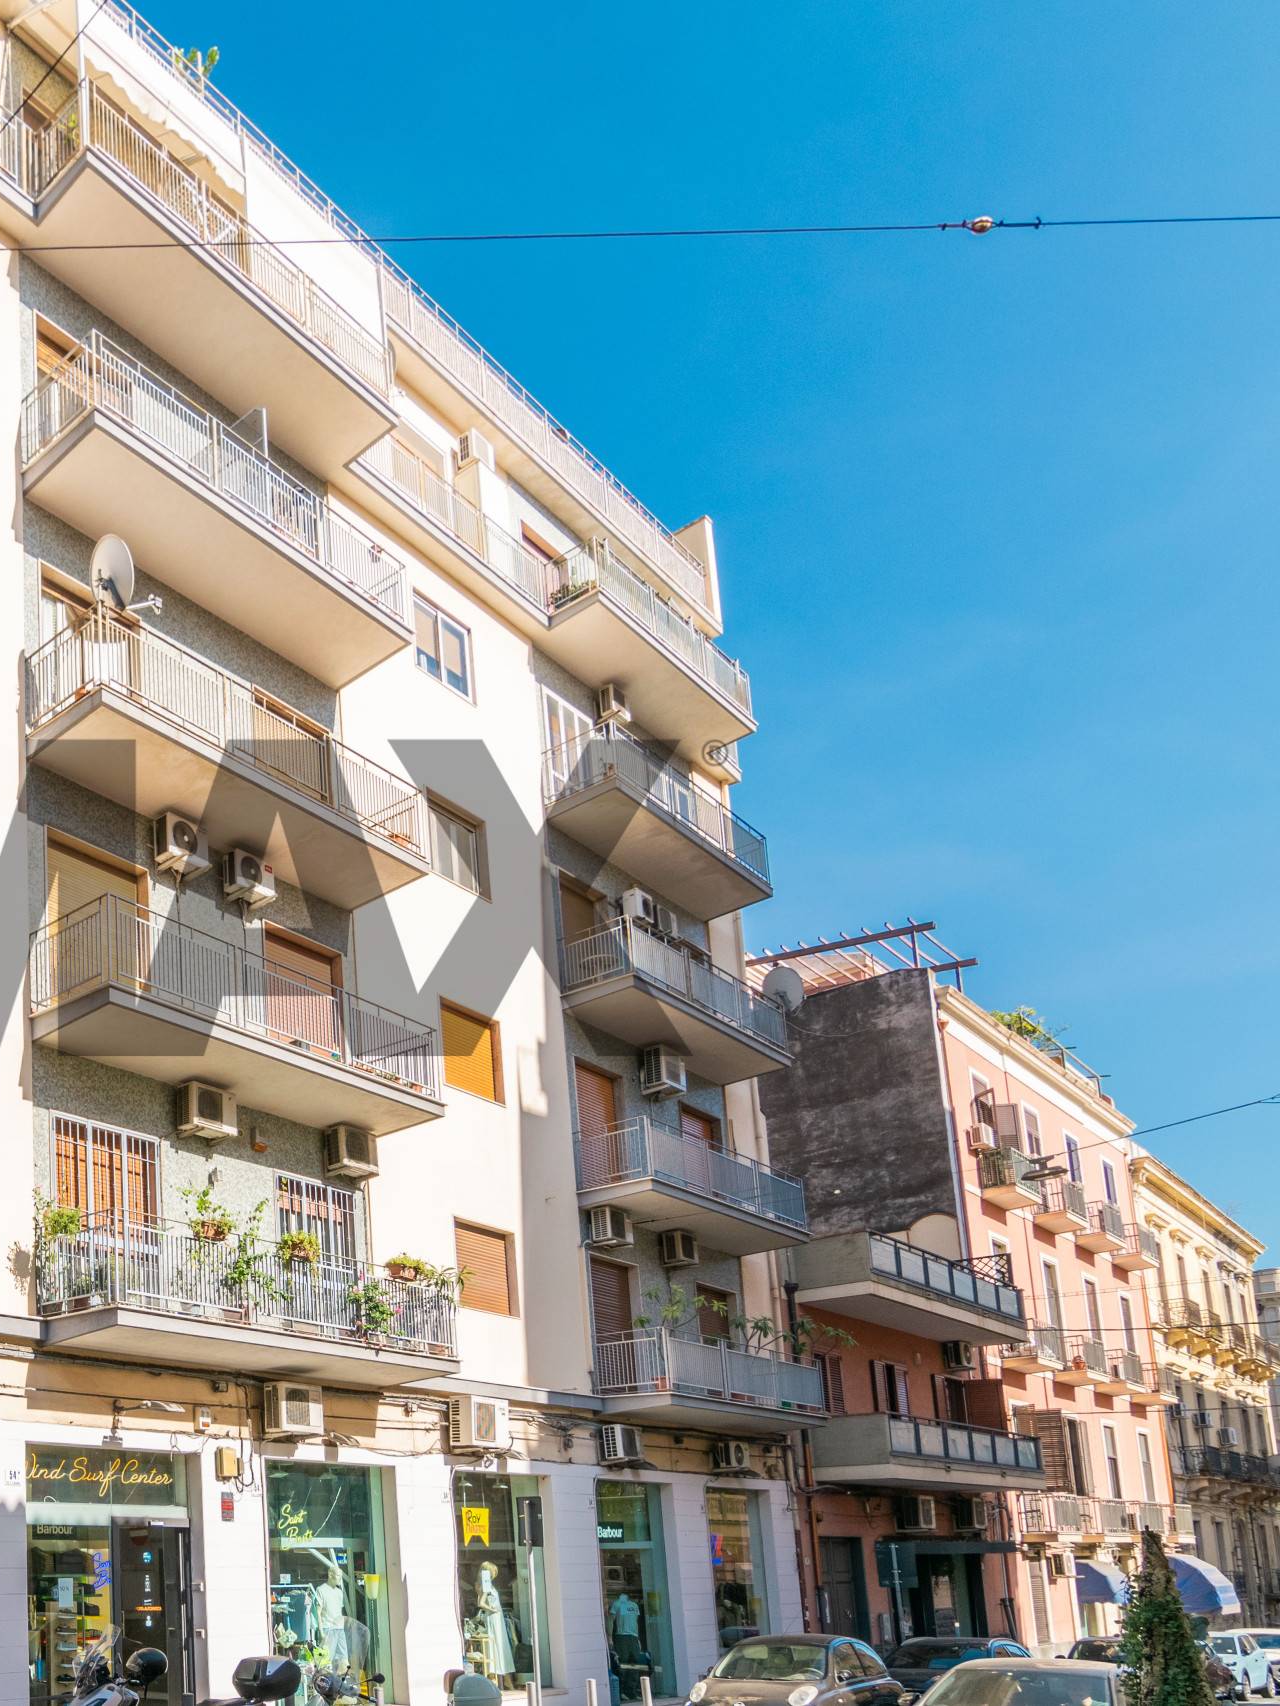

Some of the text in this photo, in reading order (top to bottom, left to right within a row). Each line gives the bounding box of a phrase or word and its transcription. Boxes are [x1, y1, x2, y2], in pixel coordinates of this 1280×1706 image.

[69, 1457, 120, 1497] Surf
[121, 1458, 173, 1485] Center
[37, 1523, 72, 1535] Barbour
[597, 1526, 623, 1538] Barbour
